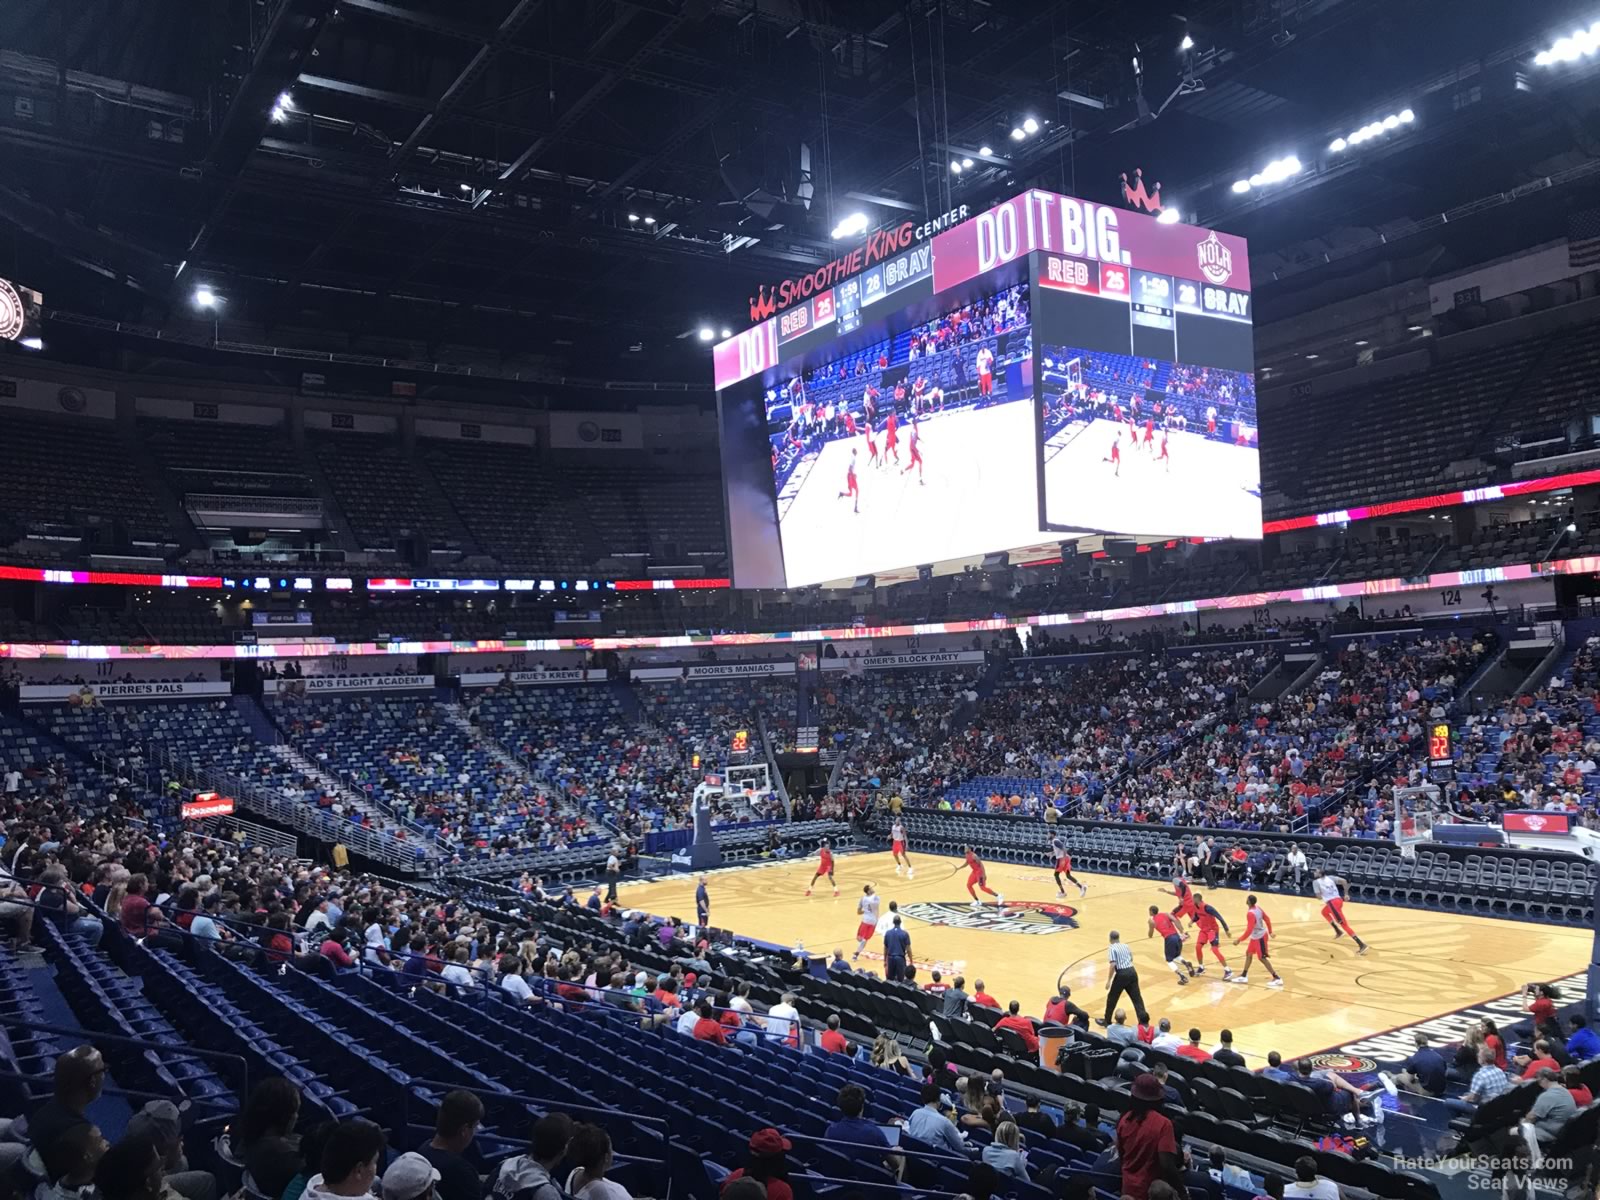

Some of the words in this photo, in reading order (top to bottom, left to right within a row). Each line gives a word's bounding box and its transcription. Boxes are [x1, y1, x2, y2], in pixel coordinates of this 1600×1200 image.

[976, 203, 1018, 272] DO
[1025, 190, 1053, 250] IT
[1060, 197, 1132, 266] BIG.
[777, 248, 863, 309] SMOOTHIE
[915, 204, 968, 240] CENTER
[1199, 243, 1231, 271] NOLA
[885, 245, 931, 286] GRAY
[1048, 257, 1089, 286] RED
[1106, 270, 1125, 290] 25
[840, 281, 858, 299] 1:59
[866, 274, 881, 291] 28
[1204, 287, 1249, 316] GRAY
[781, 307, 808, 336] RED
[817, 298, 831, 317] 25
[738, 326, 765, 379] DO
[1440, 590, 1461, 606] 124
[1253, 609, 1270, 623] 123
[1096, 624, 1113, 636] 122
[906, 637, 920, 648] 121
[863, 657, 896, 665] OMER'S
[898, 655, 926, 663] BLOCK
[928, 653, 959, 661] PARTY
[96, 662, 114, 675] 117
[514, 671, 546, 681] JRUE'S
[549, 670, 581, 679] KREWE
[694, 665, 733, 675] MOORE'S
[735, 664, 775, 673] MANIACS
[100, 685, 152, 695] PIERRE'S
[156, 684, 183, 693] PALS
[309, 680, 333, 688] AD'S
[337, 678, 374, 687] FLIGHT
[377, 677, 426, 686] ACADEMY
[732, 738, 746, 750] 22
[1431, 737, 1448, 757] 22
